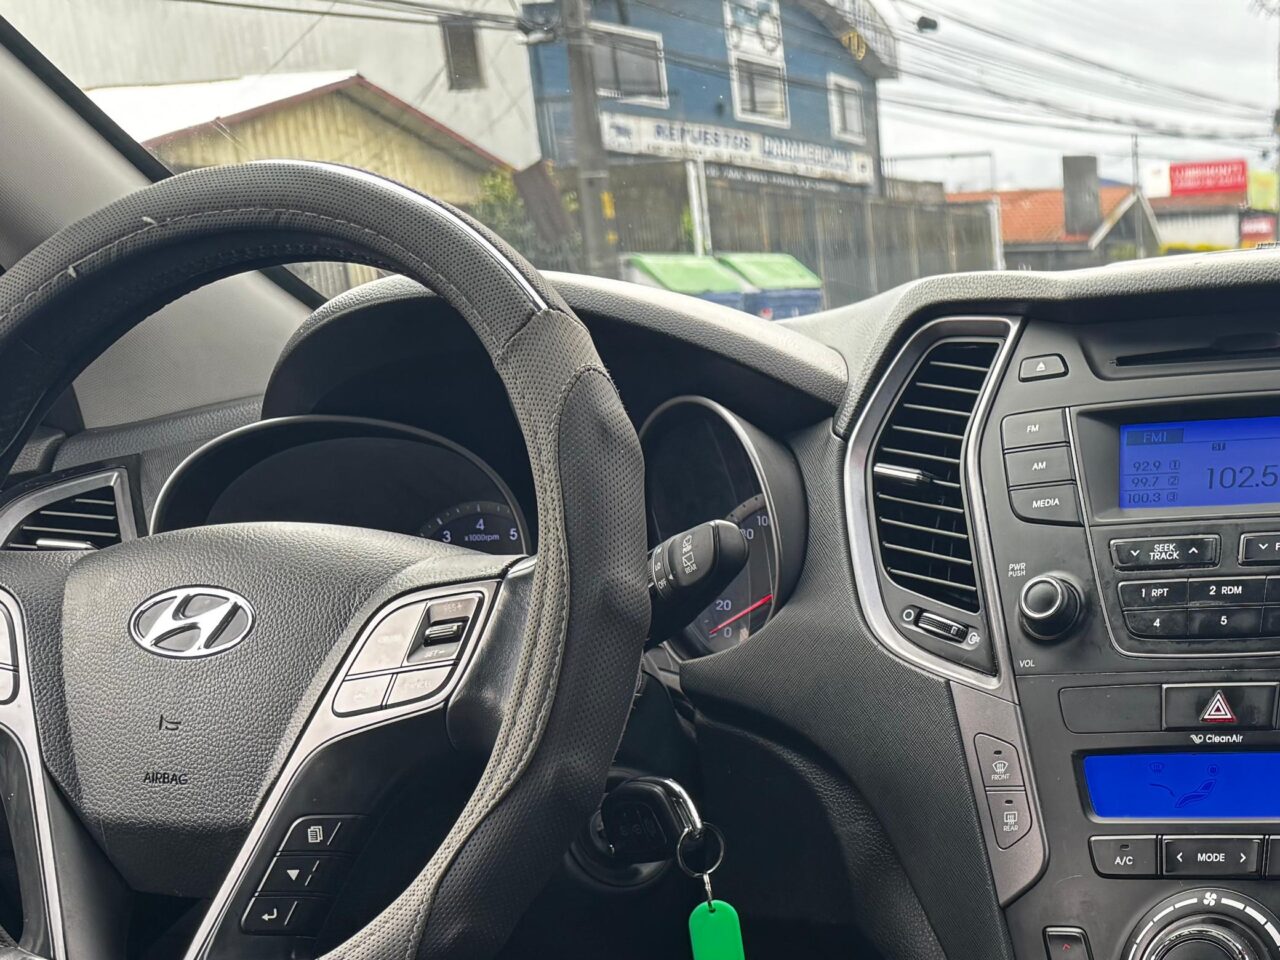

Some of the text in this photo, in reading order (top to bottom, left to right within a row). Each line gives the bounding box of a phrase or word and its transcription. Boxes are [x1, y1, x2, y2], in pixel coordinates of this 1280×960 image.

[1027, 425, 1039, 433] FM
[1032, 462, 1046, 471] AM
[1133, 460, 1161, 472] 92.9
[1131, 476, 1159, 487] 99.7
[1206, 464, 1279, 490] 102.5
[1032, 498, 1060, 508] MEDIA
[1128, 492, 1161, 504] 100.3
[476, 518, 484, 530] 4
[443, 530, 451, 542] 3
[509, 528, 518, 540] 5
[1154, 543, 1176, 552] SEEK
[1149, 551, 1180, 561] TRACK
[1008, 563, 1026, 571] PWR
[1141, 588, 1169, 598] 1 RPT
[1209, 586, 1242, 595] 2 RDM
[716, 600, 731, 610] 20
[1153, 618, 1161, 628] 4
[1220, 616, 1228, 626] 5
[723, 627, 731, 638] 0
[1020, 660, 1035, 668] VOL
[1205, 734, 1243, 743] CleanAir
[143, 772, 189, 785] AIRBAG
[1114, 855, 1133, 866] A/C
[1197, 852, 1226, 862] MODE
